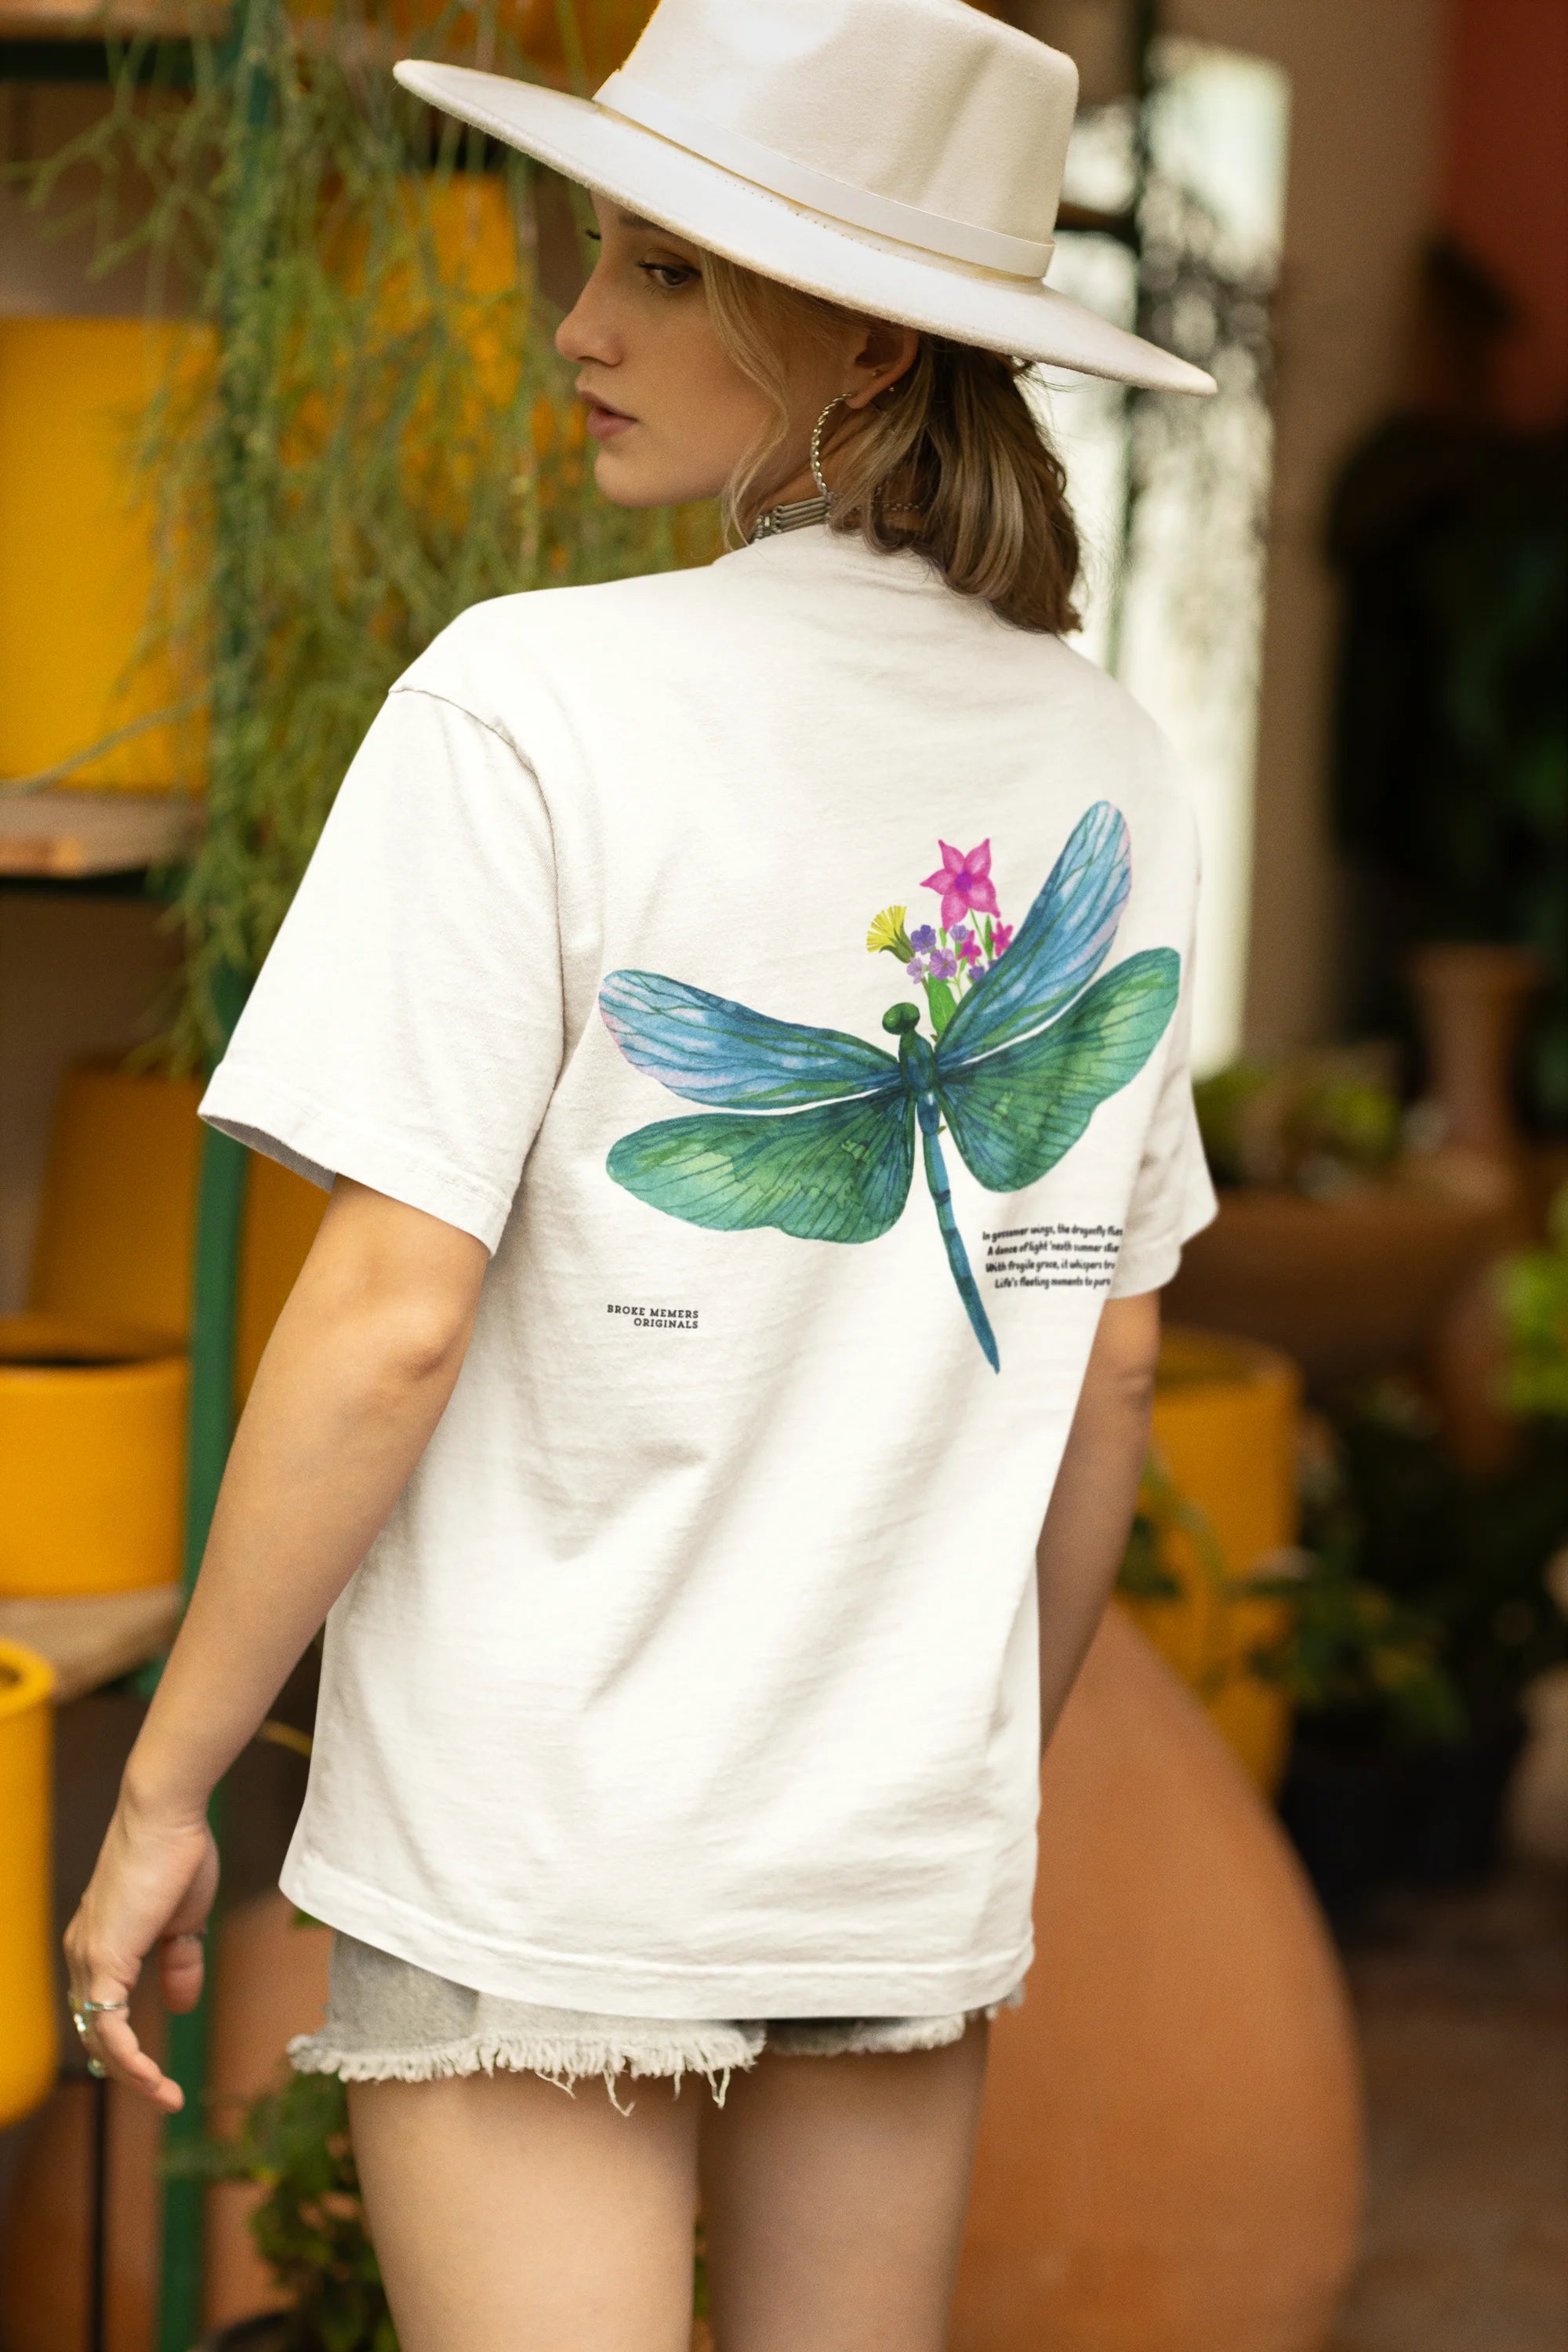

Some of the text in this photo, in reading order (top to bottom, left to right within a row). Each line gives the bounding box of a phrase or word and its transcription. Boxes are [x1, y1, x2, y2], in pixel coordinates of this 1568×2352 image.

[982, 1232, 990, 1240] In
[992, 1228, 1029, 1243] gossamer
[1030, 1225, 1055, 1237] wings,
[1057, 1223, 1069, 1234] the
[1071, 1225, 1105, 1239] dragonfly
[987, 1246, 993, 1256] A
[995, 1245, 1018, 1255] dance
[1019, 1242, 1029, 1253] of
[1029, 1240, 1047, 1254] light
[985, 1261, 1007, 1272] With
[1008, 1259, 1035, 1273] fragile
[1036, 1261, 1059, 1272] grace,
[1061, 1258, 1068, 1269] it
[1069, 1259, 1102, 1272] whispers
[995, 1277, 1018, 1289] Life's
[1020, 1276, 1050, 1290] fleeting
[1051, 1276, 1083, 1286] moments
[1084, 1276, 1093, 1286] to
[607, 1305, 699, 1319] BROKE MEMERS
[633, 1317, 699, 1329] ORIGINALS
